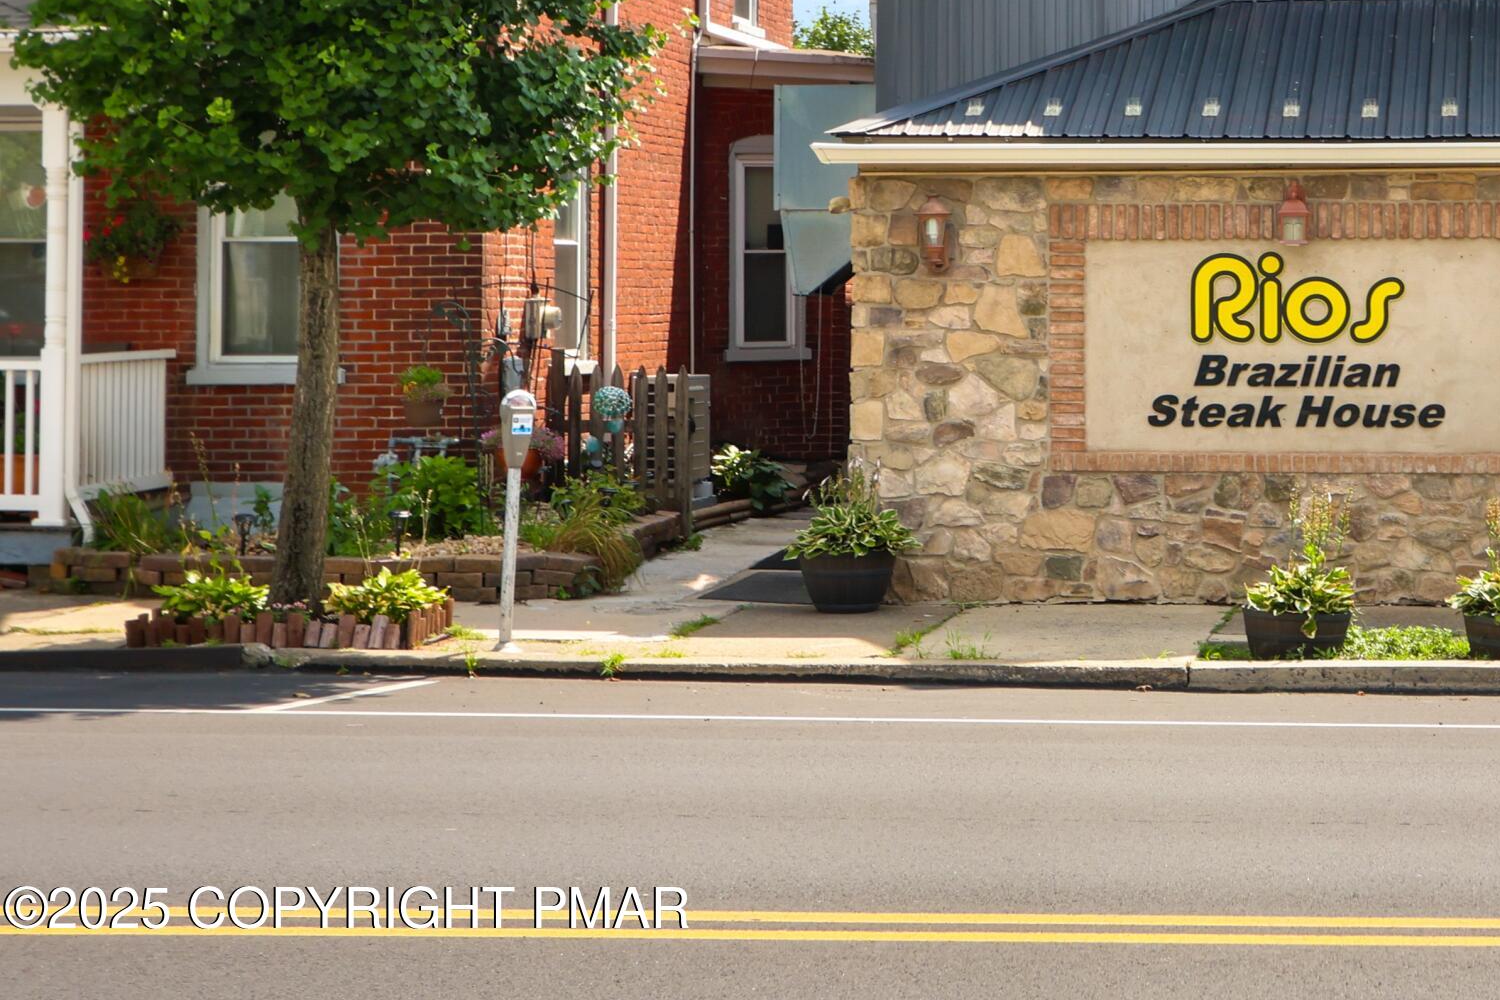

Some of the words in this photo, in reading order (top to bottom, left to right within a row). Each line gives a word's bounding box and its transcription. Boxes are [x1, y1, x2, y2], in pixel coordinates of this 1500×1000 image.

[1191, 252, 1405, 343] Rios
[1194, 355, 1400, 387] Brazilian
[1147, 395, 1286, 428] Steak
[1296, 396, 1446, 428] House
